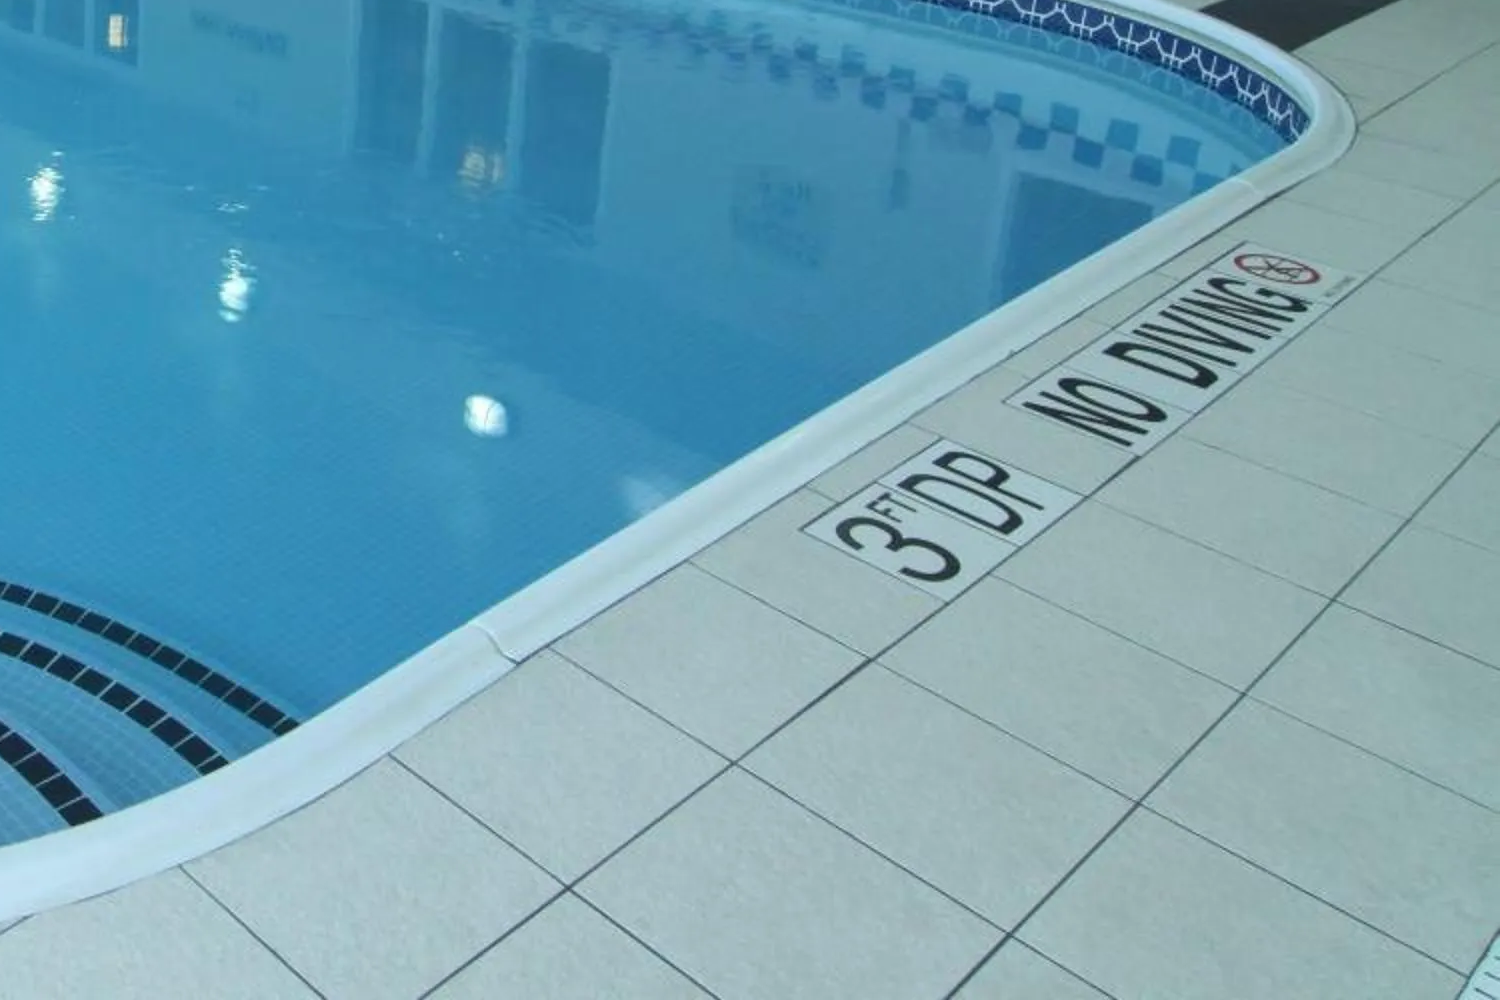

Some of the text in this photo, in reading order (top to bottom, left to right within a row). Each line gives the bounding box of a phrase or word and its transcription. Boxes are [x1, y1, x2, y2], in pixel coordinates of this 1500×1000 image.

[1022, 277, 1313, 447] NO DIVING
[898, 451, 1045, 535] DP
